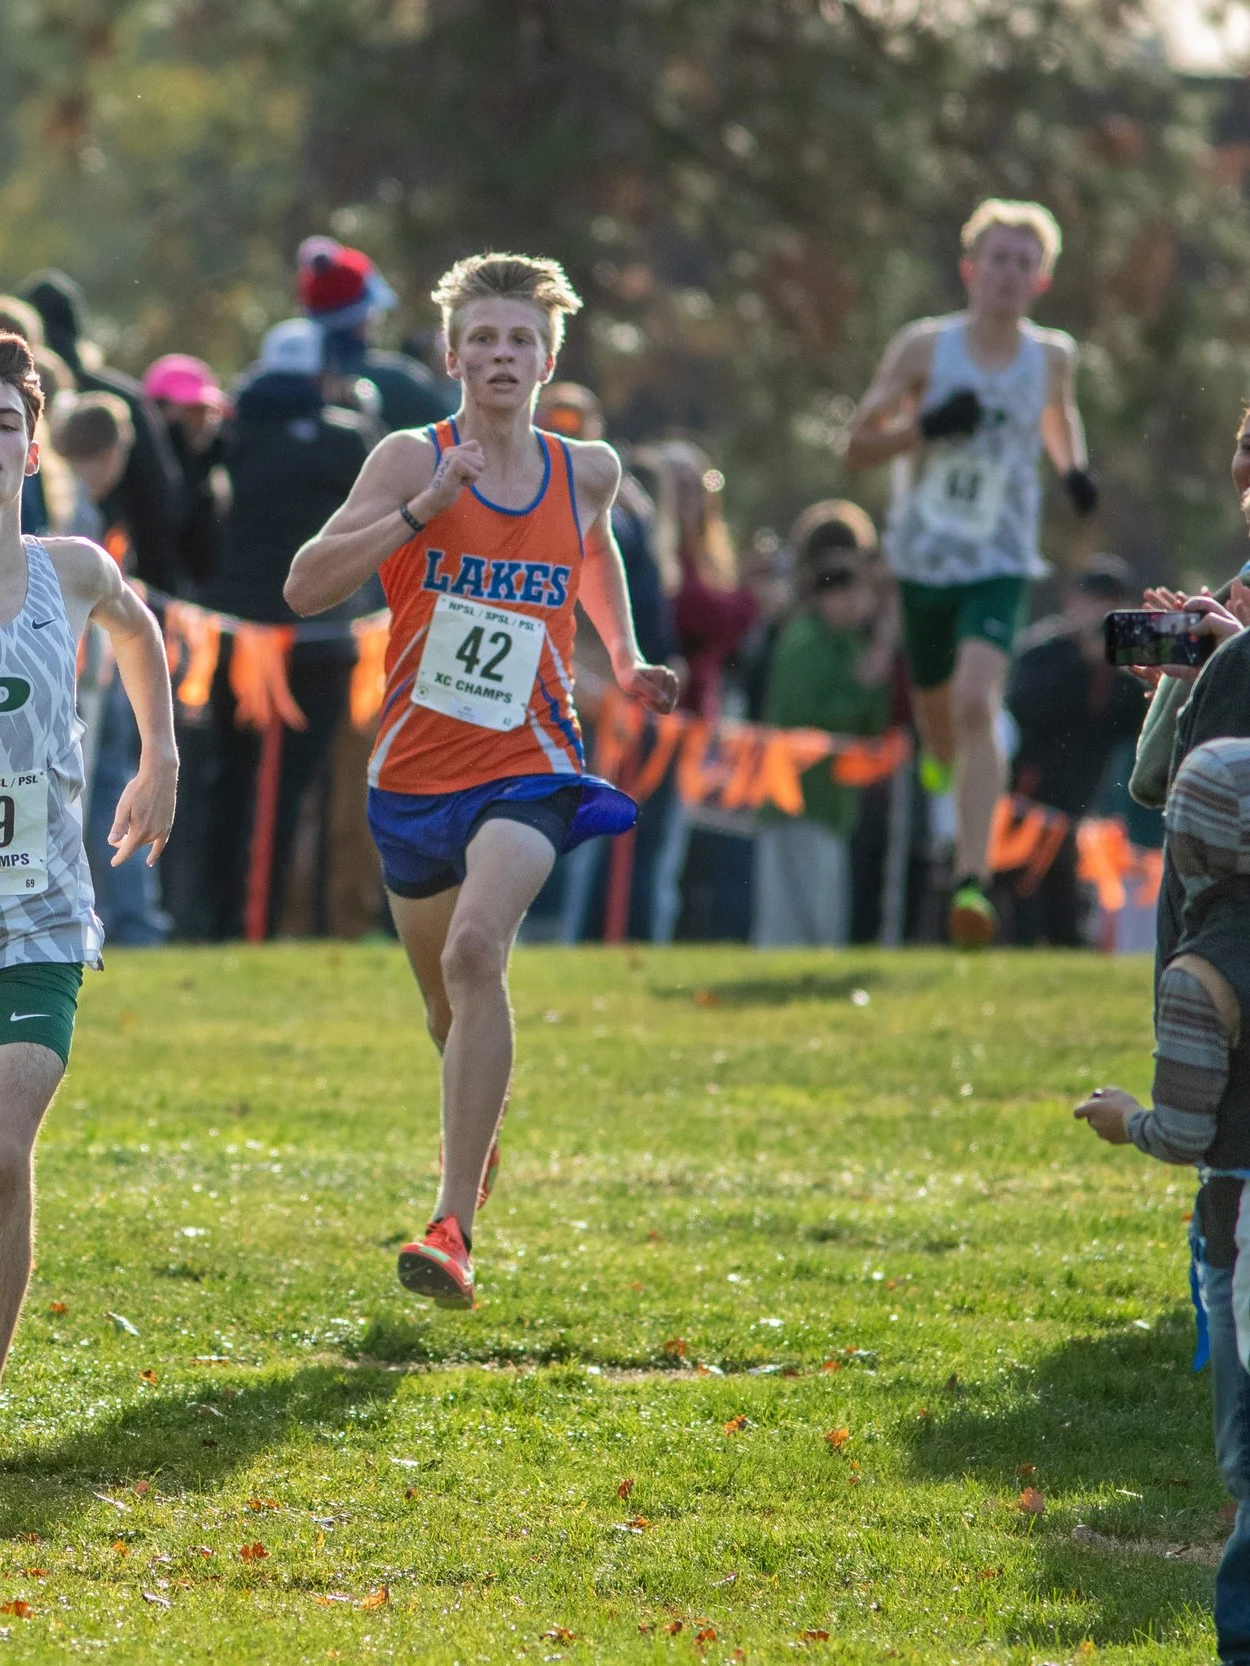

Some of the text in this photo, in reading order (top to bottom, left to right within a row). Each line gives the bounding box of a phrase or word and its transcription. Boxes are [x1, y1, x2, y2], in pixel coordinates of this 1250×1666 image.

[422, 548, 572, 610] LAKES
[448, 602, 475, 616] NPSL
[484, 611, 510, 625] SPSL
[518, 620, 535, 631] PSL
[454, 625, 513, 683] 42
[434, 672, 513, 704] XC CHAMPS
[18, 775, 39, 786] PSL
[25, 878, 36, 888] 69
